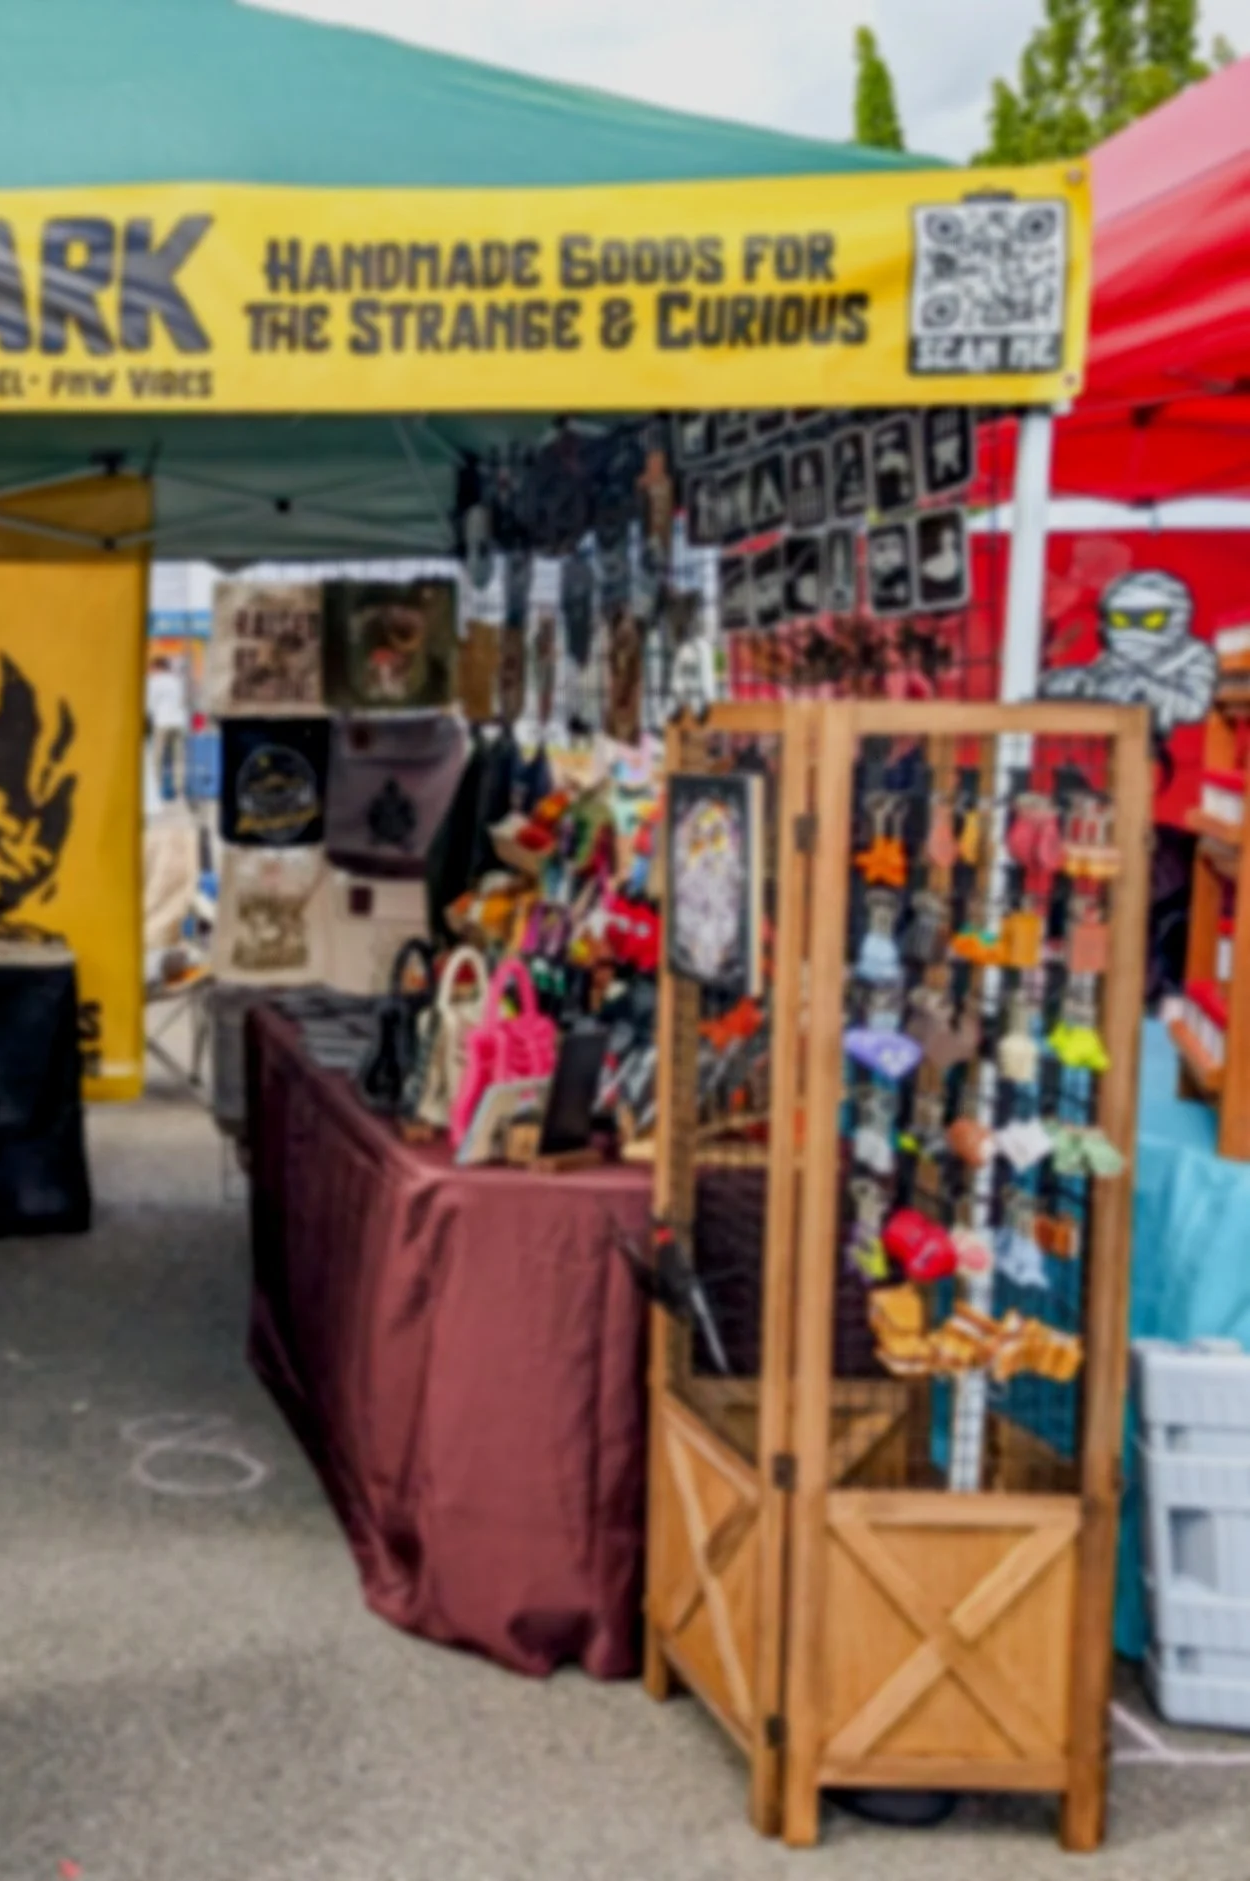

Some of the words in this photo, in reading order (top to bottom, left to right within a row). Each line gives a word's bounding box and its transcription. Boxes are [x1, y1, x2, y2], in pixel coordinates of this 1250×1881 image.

[262, 236, 542, 294] HANDMADE
[559, 232, 726, 291] GOODS
[743, 230, 837, 285] FOR
[243, 300, 331, 354] THE
[348, 297, 583, 356] STRANGE
[600, 296, 637, 350] &
[656, 289, 871, 349] CURIOUS
[915, 335, 1000, 371] SCAN
[1009, 334, 1057, 370] ME
